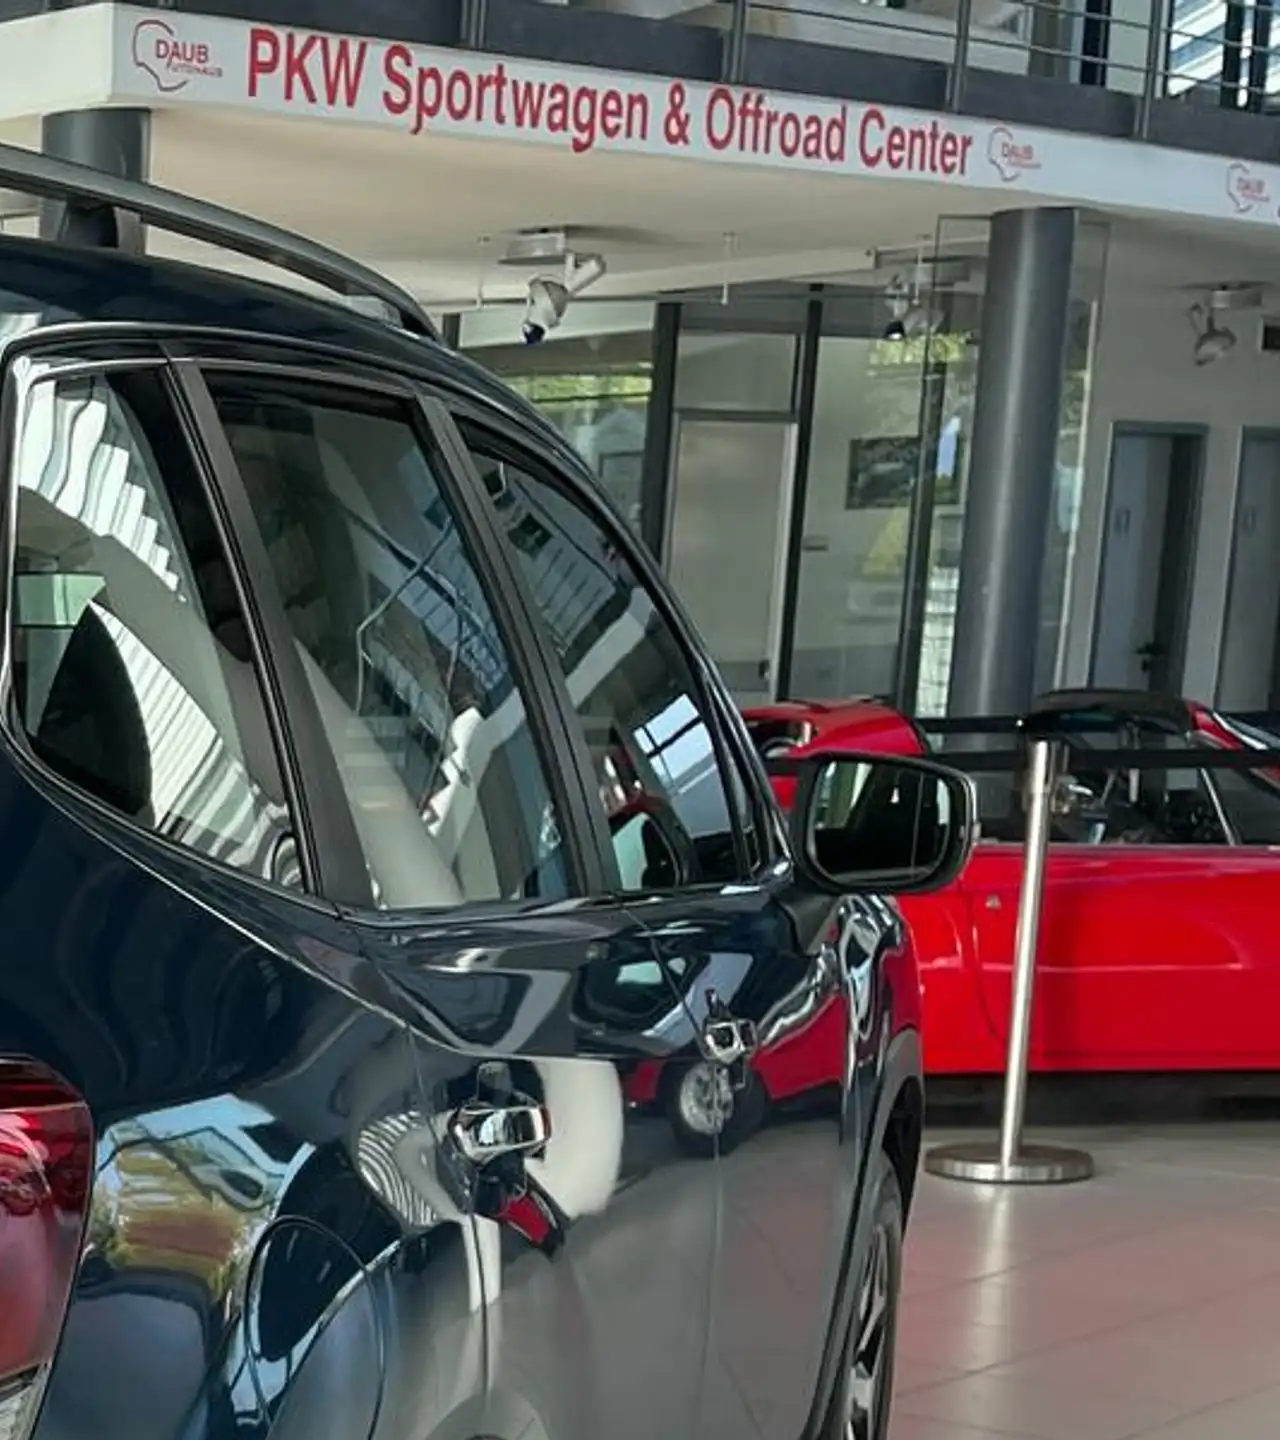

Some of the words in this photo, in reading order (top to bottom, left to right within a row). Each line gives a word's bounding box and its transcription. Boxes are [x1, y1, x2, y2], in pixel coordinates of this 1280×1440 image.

[155, 39, 209, 66] DAUB
[247, 27, 366, 110] PKW
[381, 44, 649, 153] Sportwagen
[664, 81, 691, 146] &
[704, 86, 847, 162] Offroad
[858, 105, 971, 175] Center
